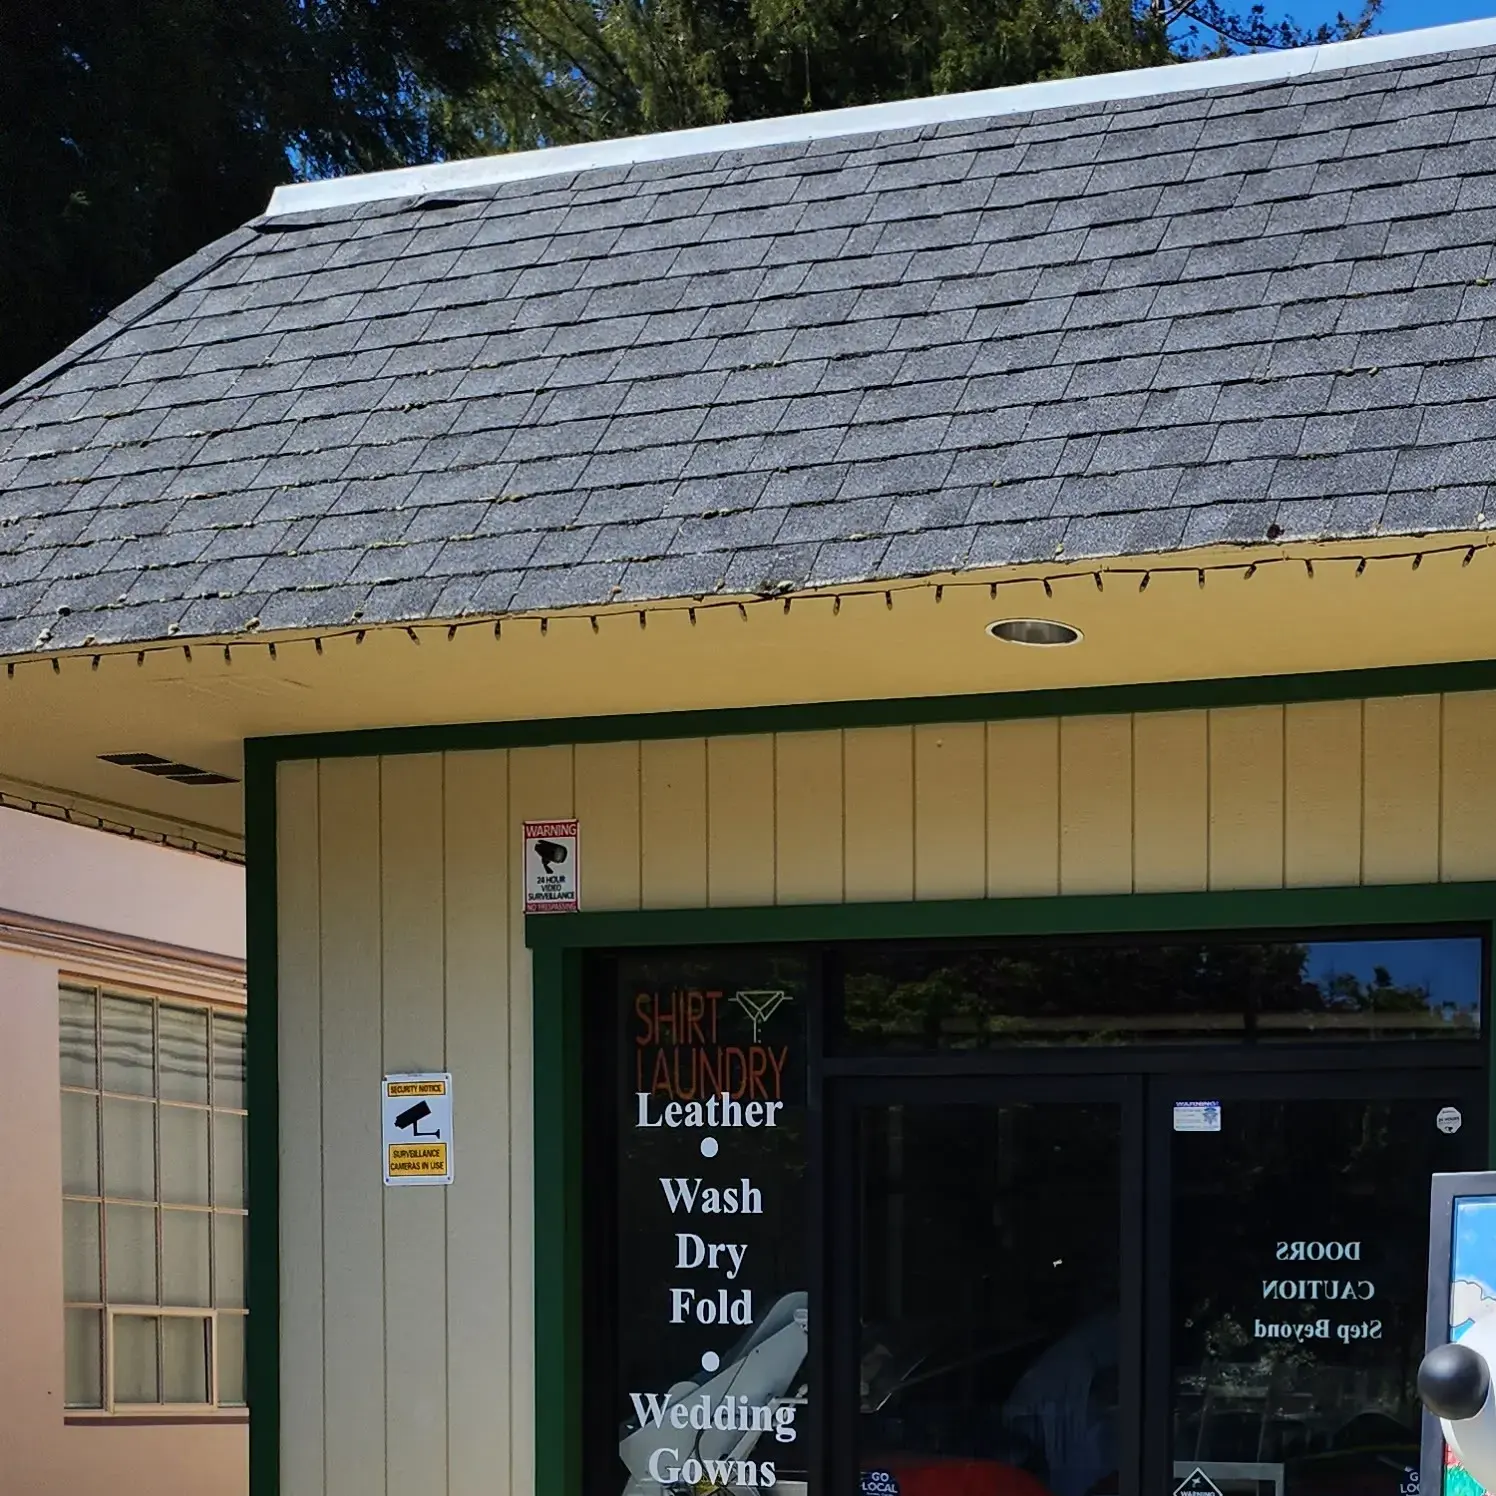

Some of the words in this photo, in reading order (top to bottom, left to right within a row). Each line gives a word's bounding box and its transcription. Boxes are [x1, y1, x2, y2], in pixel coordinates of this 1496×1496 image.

[526, 824, 577, 837] WARNING
[537, 876, 545, 884] 24
[546, 875, 566, 884] HOUR
[541, 884, 562, 892] VIDEO
[528, 892, 575, 900] SURVEILLANCE
[635, 989, 723, 1045] SHIRT
[637, 1045, 789, 1101] LAUNDRY
[390, 1085, 418, 1094] SECURITY
[419, 1084, 442, 1093] NOTICE
[635, 1092, 784, 1128] Leather
[393, 1149, 440, 1158] SURVEILLANCE
[390, 1162, 421, 1171] CAMERAS
[422, 1162, 429, 1170] IN
[430, 1161, 444, 1170] USE
[659, 1178, 763, 1213] Wash
[675, 1233, 748, 1279] Dry
[669, 1288, 753, 1325] Fold
[629, 1393, 797, 1442] Wedding
[649, 1447, 776, 1487] Gowns
[871, 1471, 890, 1482] GO
[1409, 1471, 1419, 1482] G
[862, 1482, 898, 1494] LOCAL
